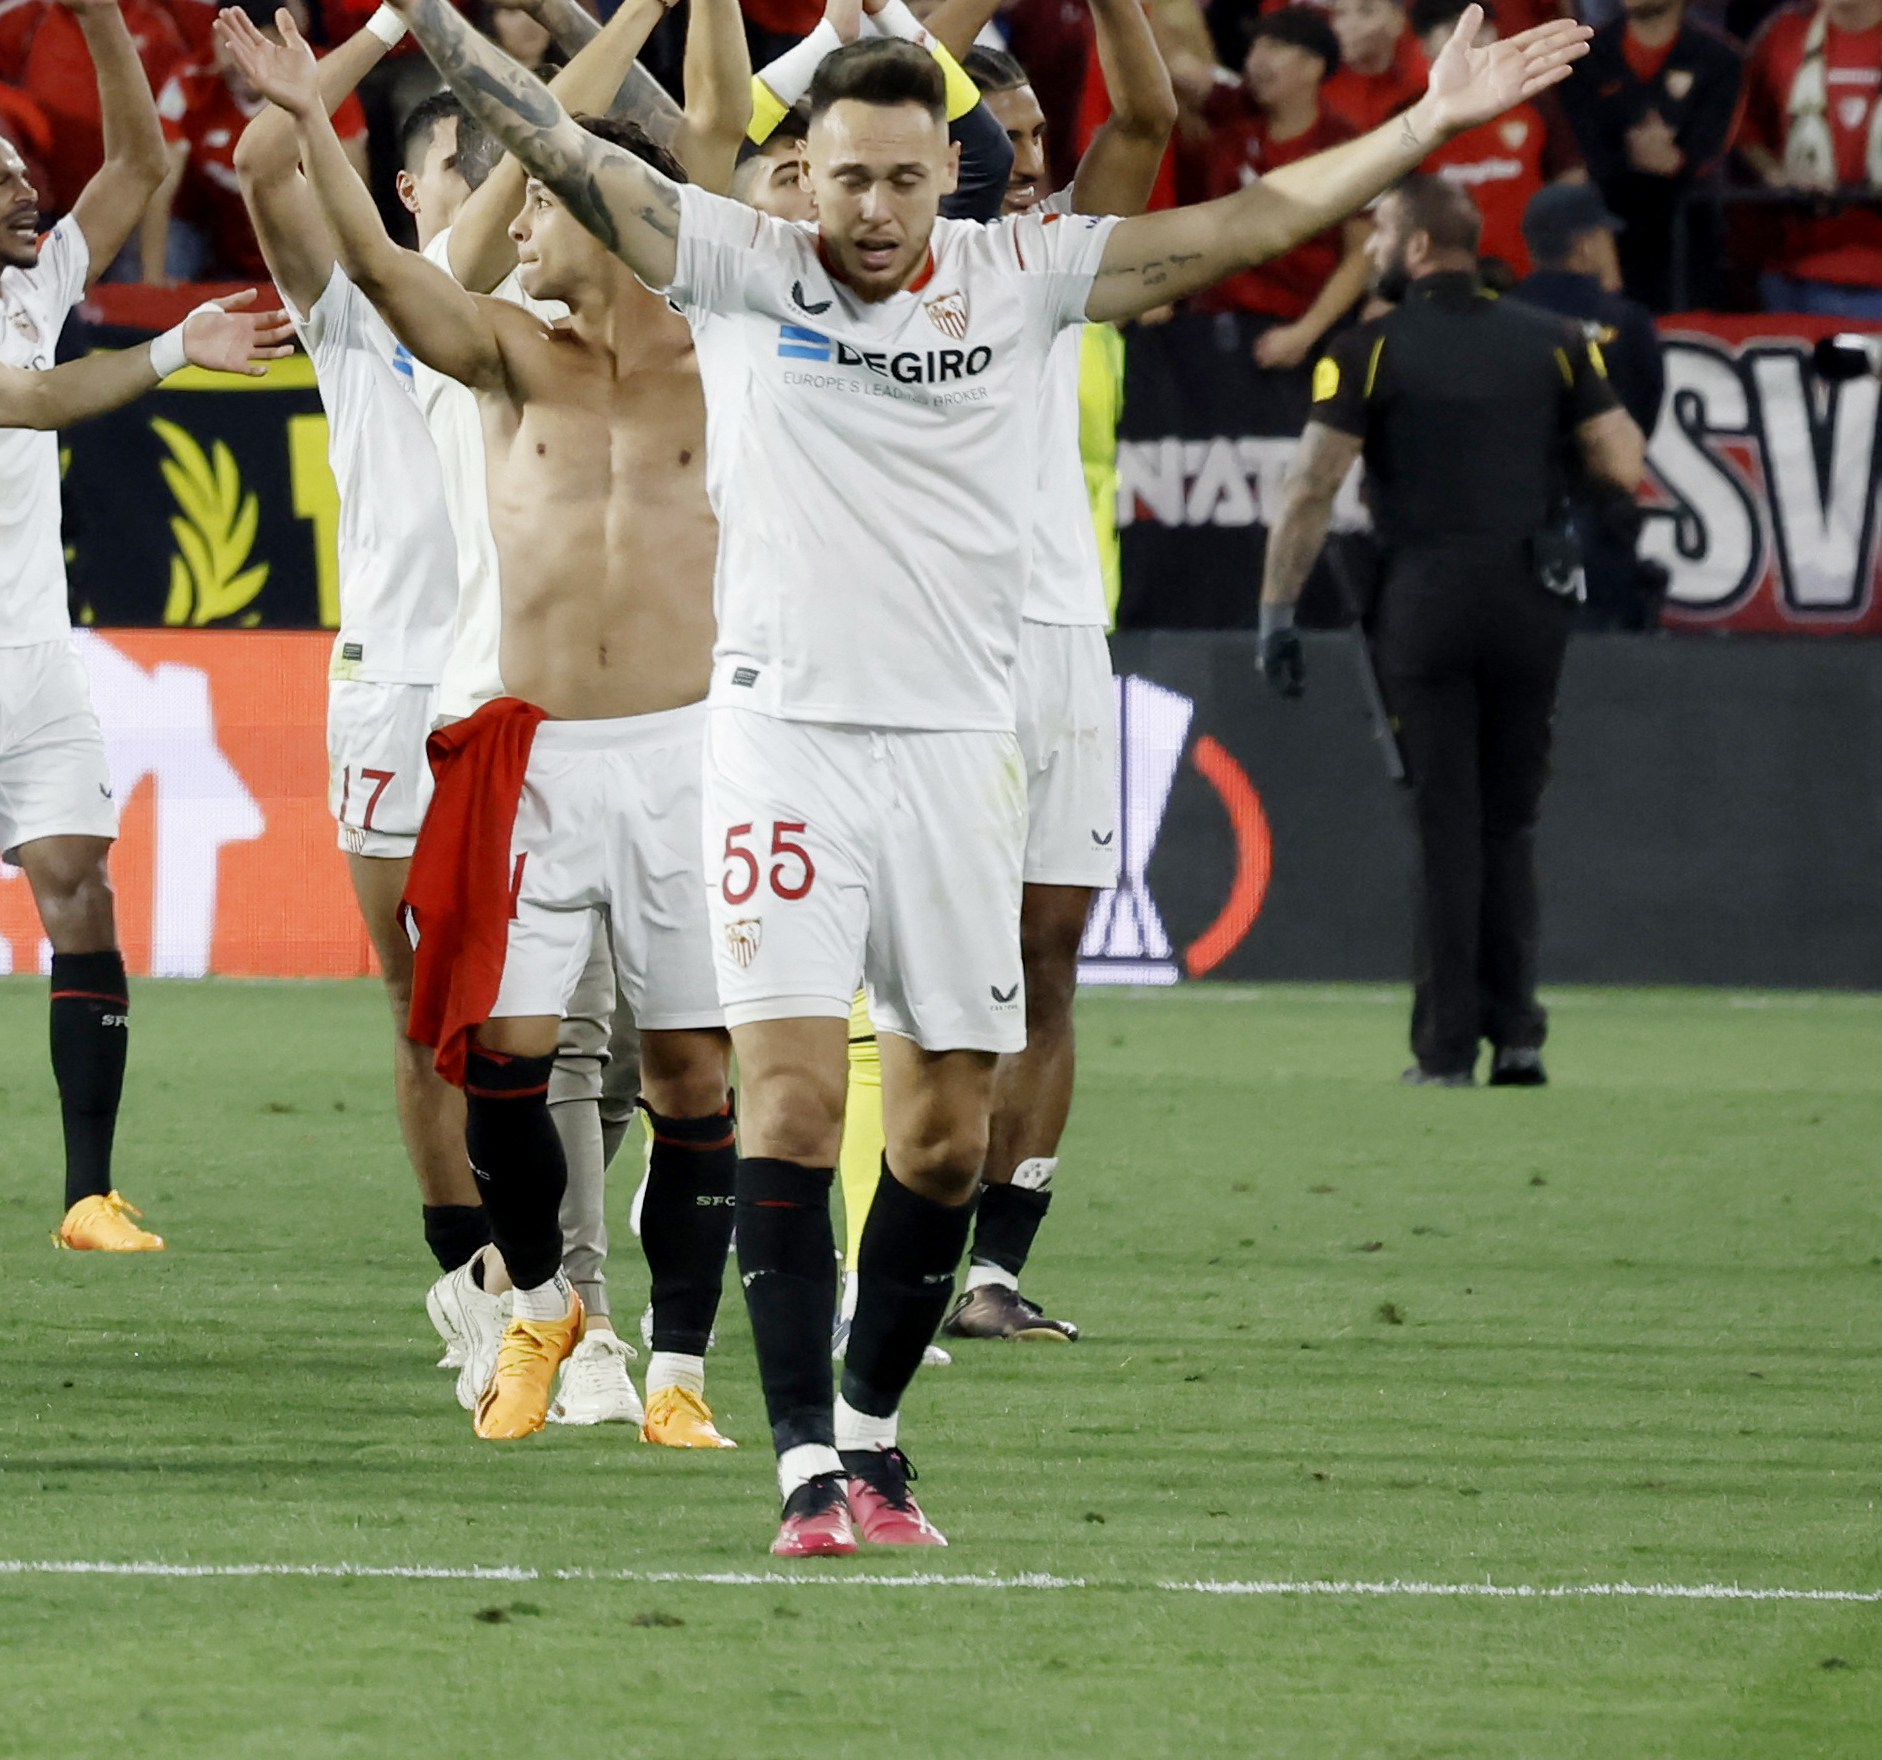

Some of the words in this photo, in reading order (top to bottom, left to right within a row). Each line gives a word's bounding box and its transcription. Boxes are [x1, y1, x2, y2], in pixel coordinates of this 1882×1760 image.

[837, 341, 993, 384] DEGIRO
[863, 383, 929, 407] LEAD
[339, 764, 396, 833] 17
[721, 819, 817, 905] 55
